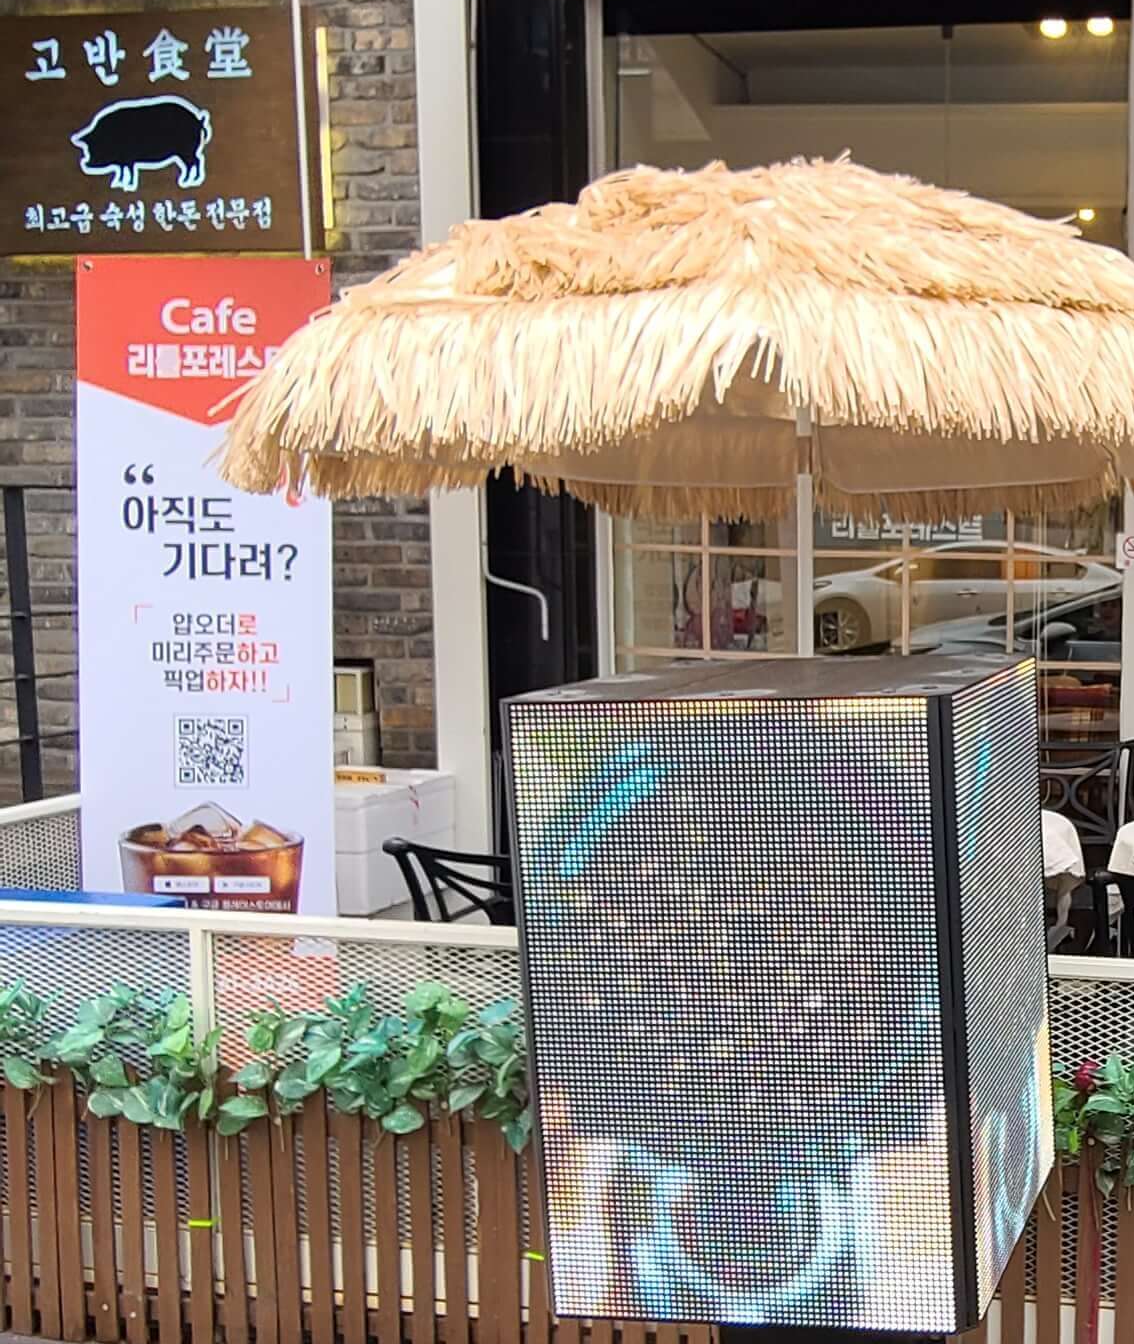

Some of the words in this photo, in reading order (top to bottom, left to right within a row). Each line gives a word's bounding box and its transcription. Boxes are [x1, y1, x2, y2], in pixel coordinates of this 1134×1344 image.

[205, 196, 273, 231] 전문점
[160, 296, 258, 336] Cafe
[122, 495, 236, 534] 아직도
[162, 542, 299, 581] 기다려?
[152, 640, 280, 666] 미리주문하고
[163, 668, 268, 693] 픽업하자!!
